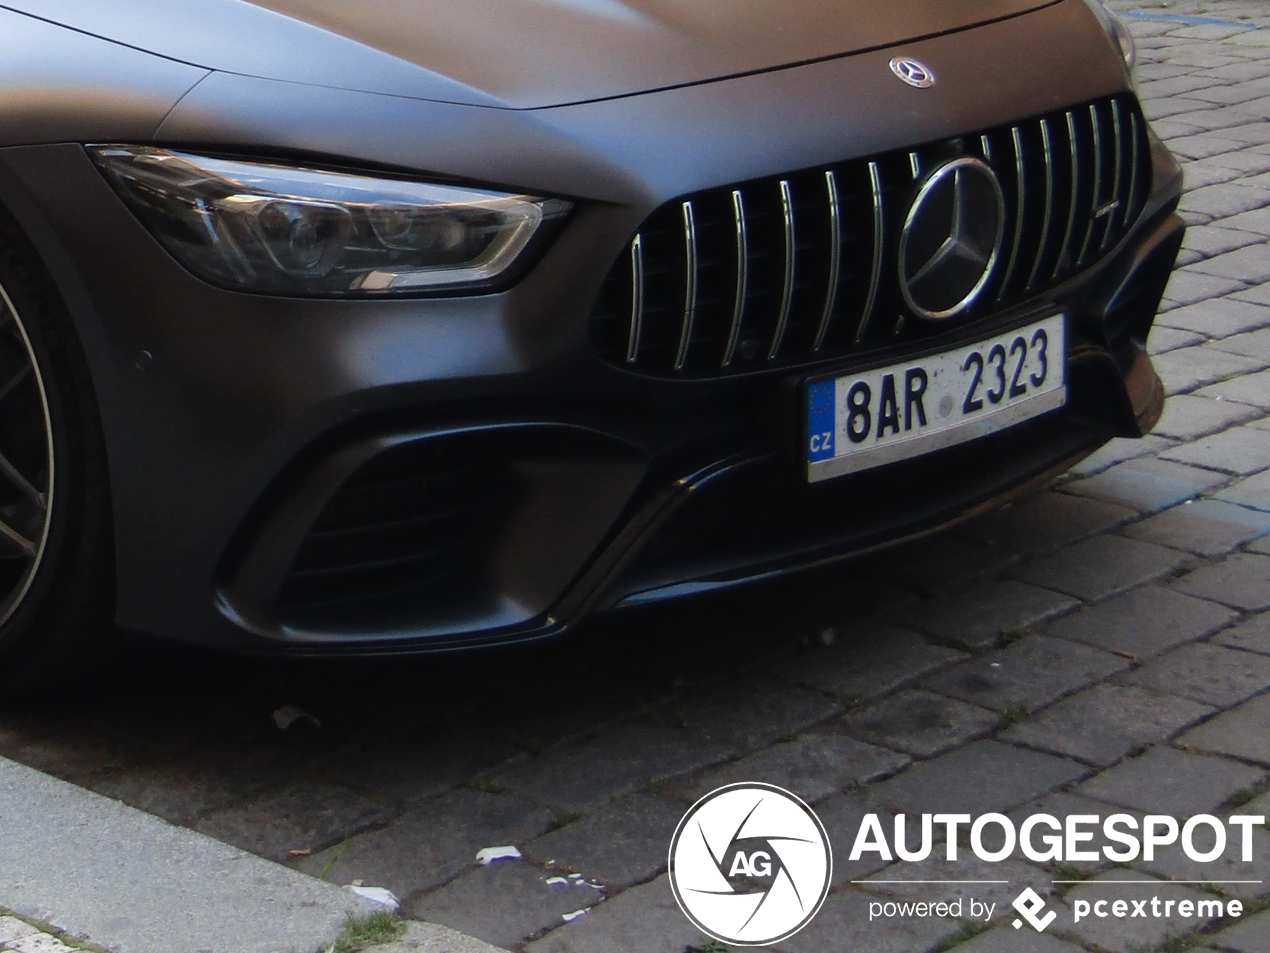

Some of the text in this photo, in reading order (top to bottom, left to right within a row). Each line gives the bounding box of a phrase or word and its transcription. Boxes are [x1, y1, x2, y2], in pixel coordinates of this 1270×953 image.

[846, 328, 1048, 443] 8AR 2323
[810, 431, 831, 452] CZ
